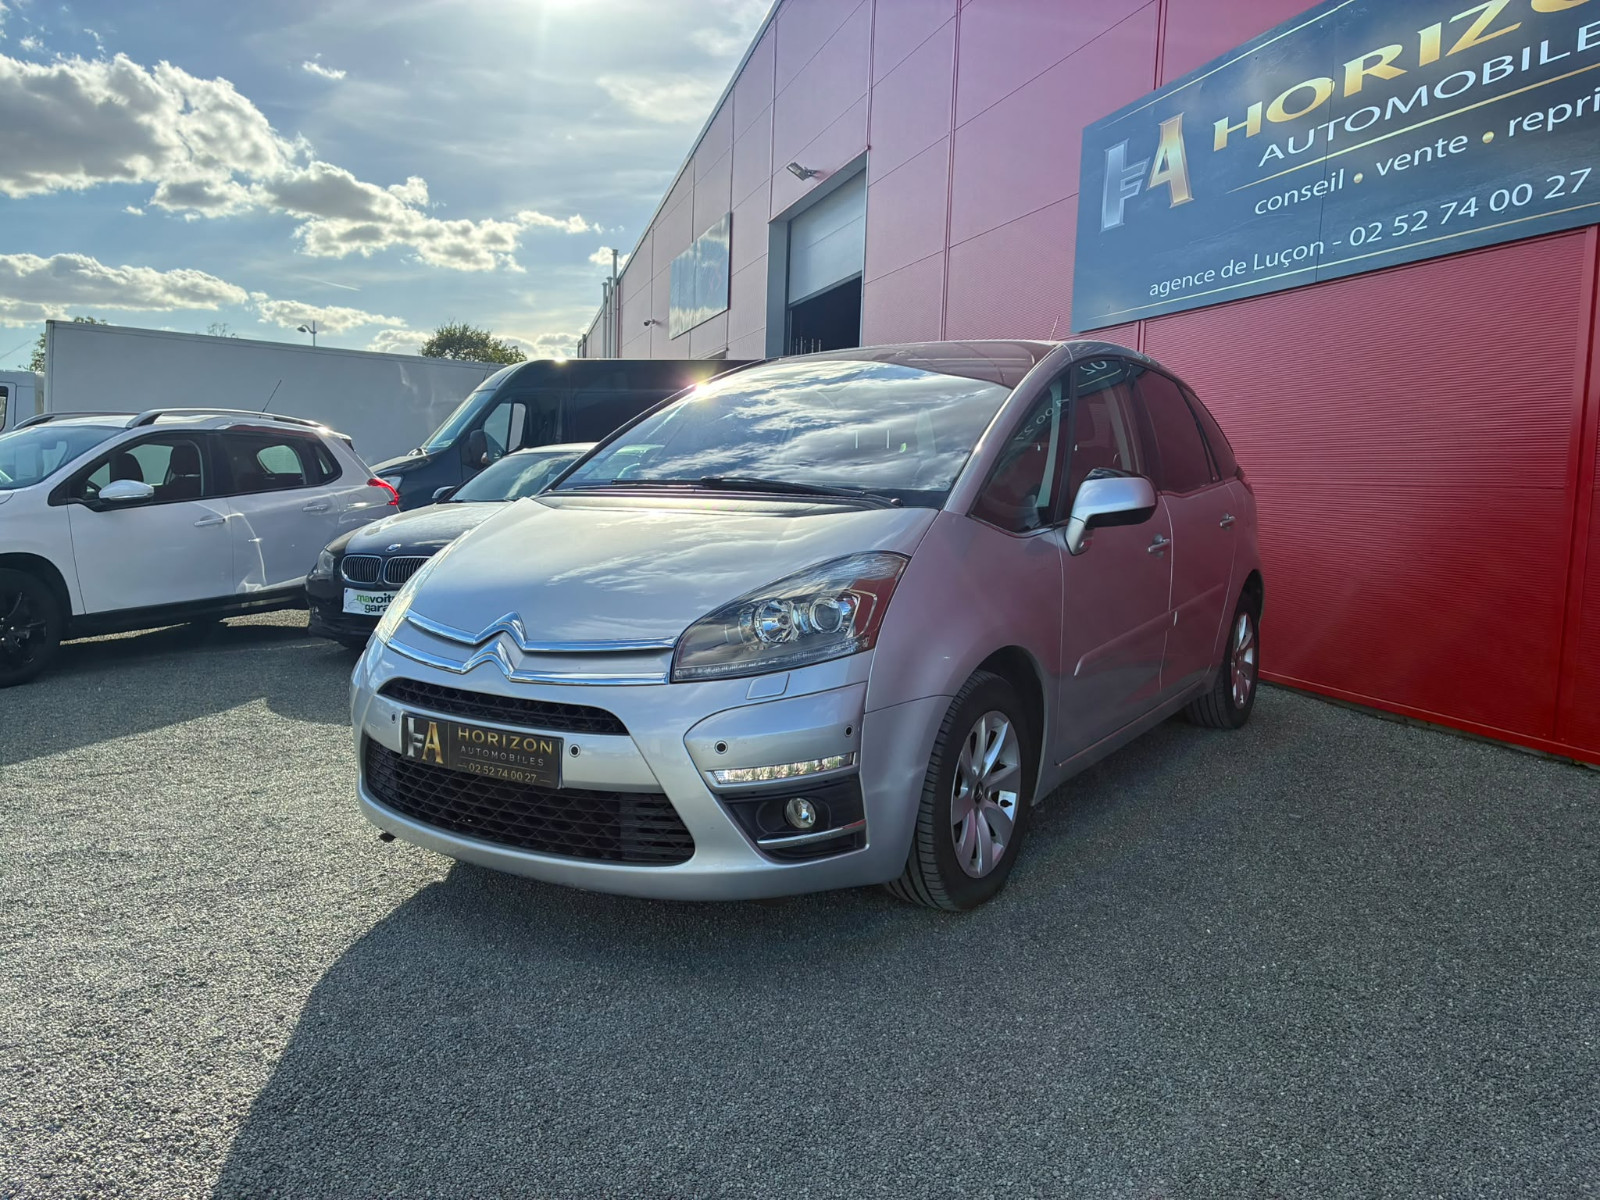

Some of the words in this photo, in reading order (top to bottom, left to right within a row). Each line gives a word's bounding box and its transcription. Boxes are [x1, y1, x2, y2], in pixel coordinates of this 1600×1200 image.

[1213, 0, 1590, 152] HORIZ
[1258, 20, 1600, 168] AUTOMOBILE
[1254, 168, 1345, 215] conseil
[1375, 135, 1468, 176] vente
[1508, 86, 1600, 137] repri
[1149, 269, 1216, 298] agence
[1220, 259, 1247, 278] de
[1253, 240, 1325, 271] Luçon
[1349, 222, 1382, 246] 02
[1391, 210, 1428, 237] 52
[1440, 197, 1479, 225] 74
[1489, 183, 1533, 212] 00
[1544, 167, 1592, 200] 27
[356, 592, 396, 604] mavoit
[458, 727, 553, 755] HORIZON
[460, 745, 544, 767] AUTOMOBILES
[468, 763, 481, 773] 02
[483, 765, 494, 776] 52
[497, 768, 508, 778] 74
[511, 771, 523, 781] 00
[525, 773, 536, 783] 27
